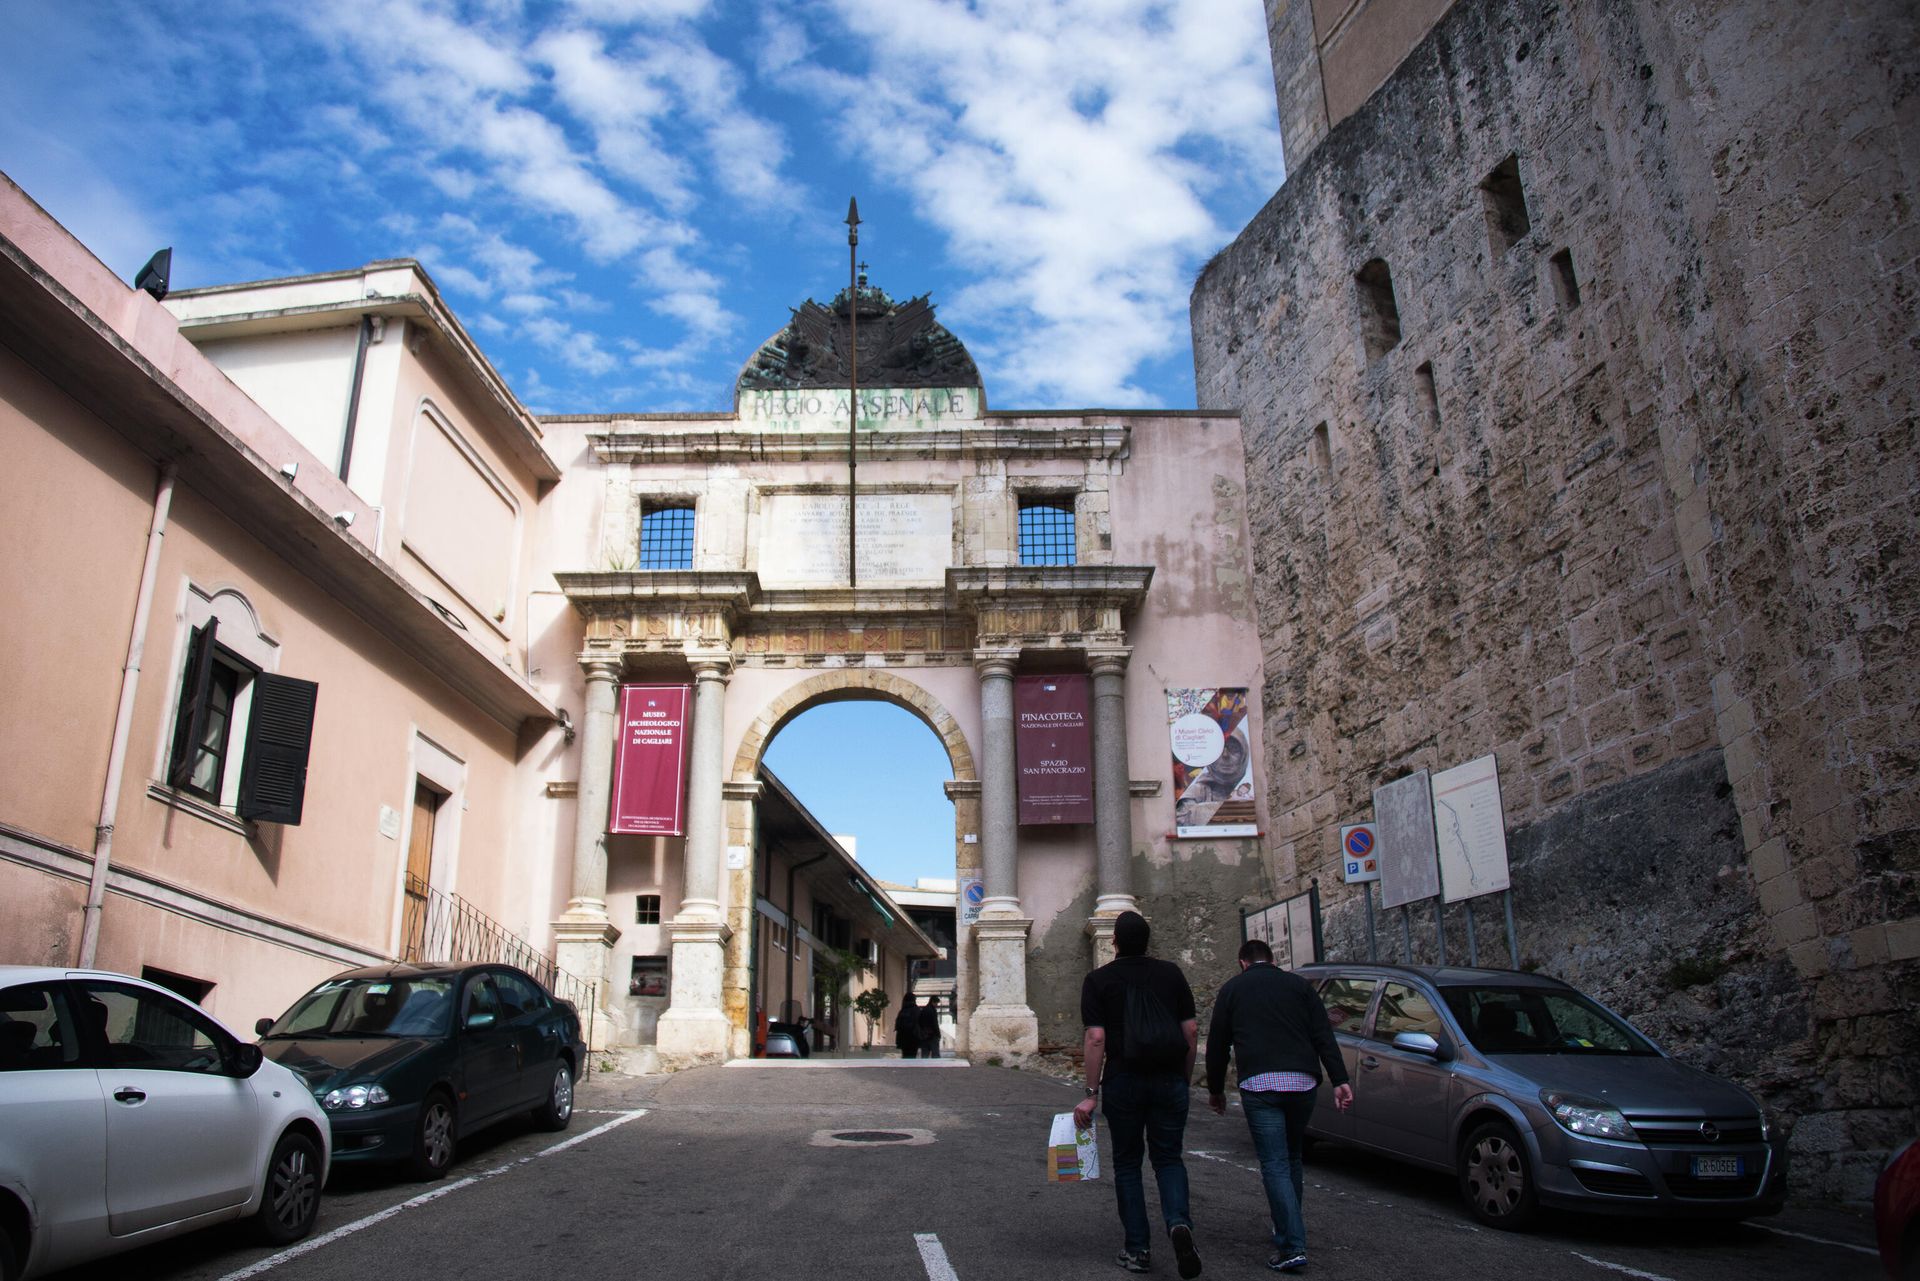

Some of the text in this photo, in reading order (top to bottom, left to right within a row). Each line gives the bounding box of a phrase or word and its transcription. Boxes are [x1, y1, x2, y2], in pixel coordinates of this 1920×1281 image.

[834, 394, 965, 416] ARSENALE
[1021, 712, 1083, 721] PINACOTECA
[1040, 759, 1068, 767] SPAZIO
[1041, 766, 1086, 774] PANCRAZIO
[1349, 864, 1357, 874] P
